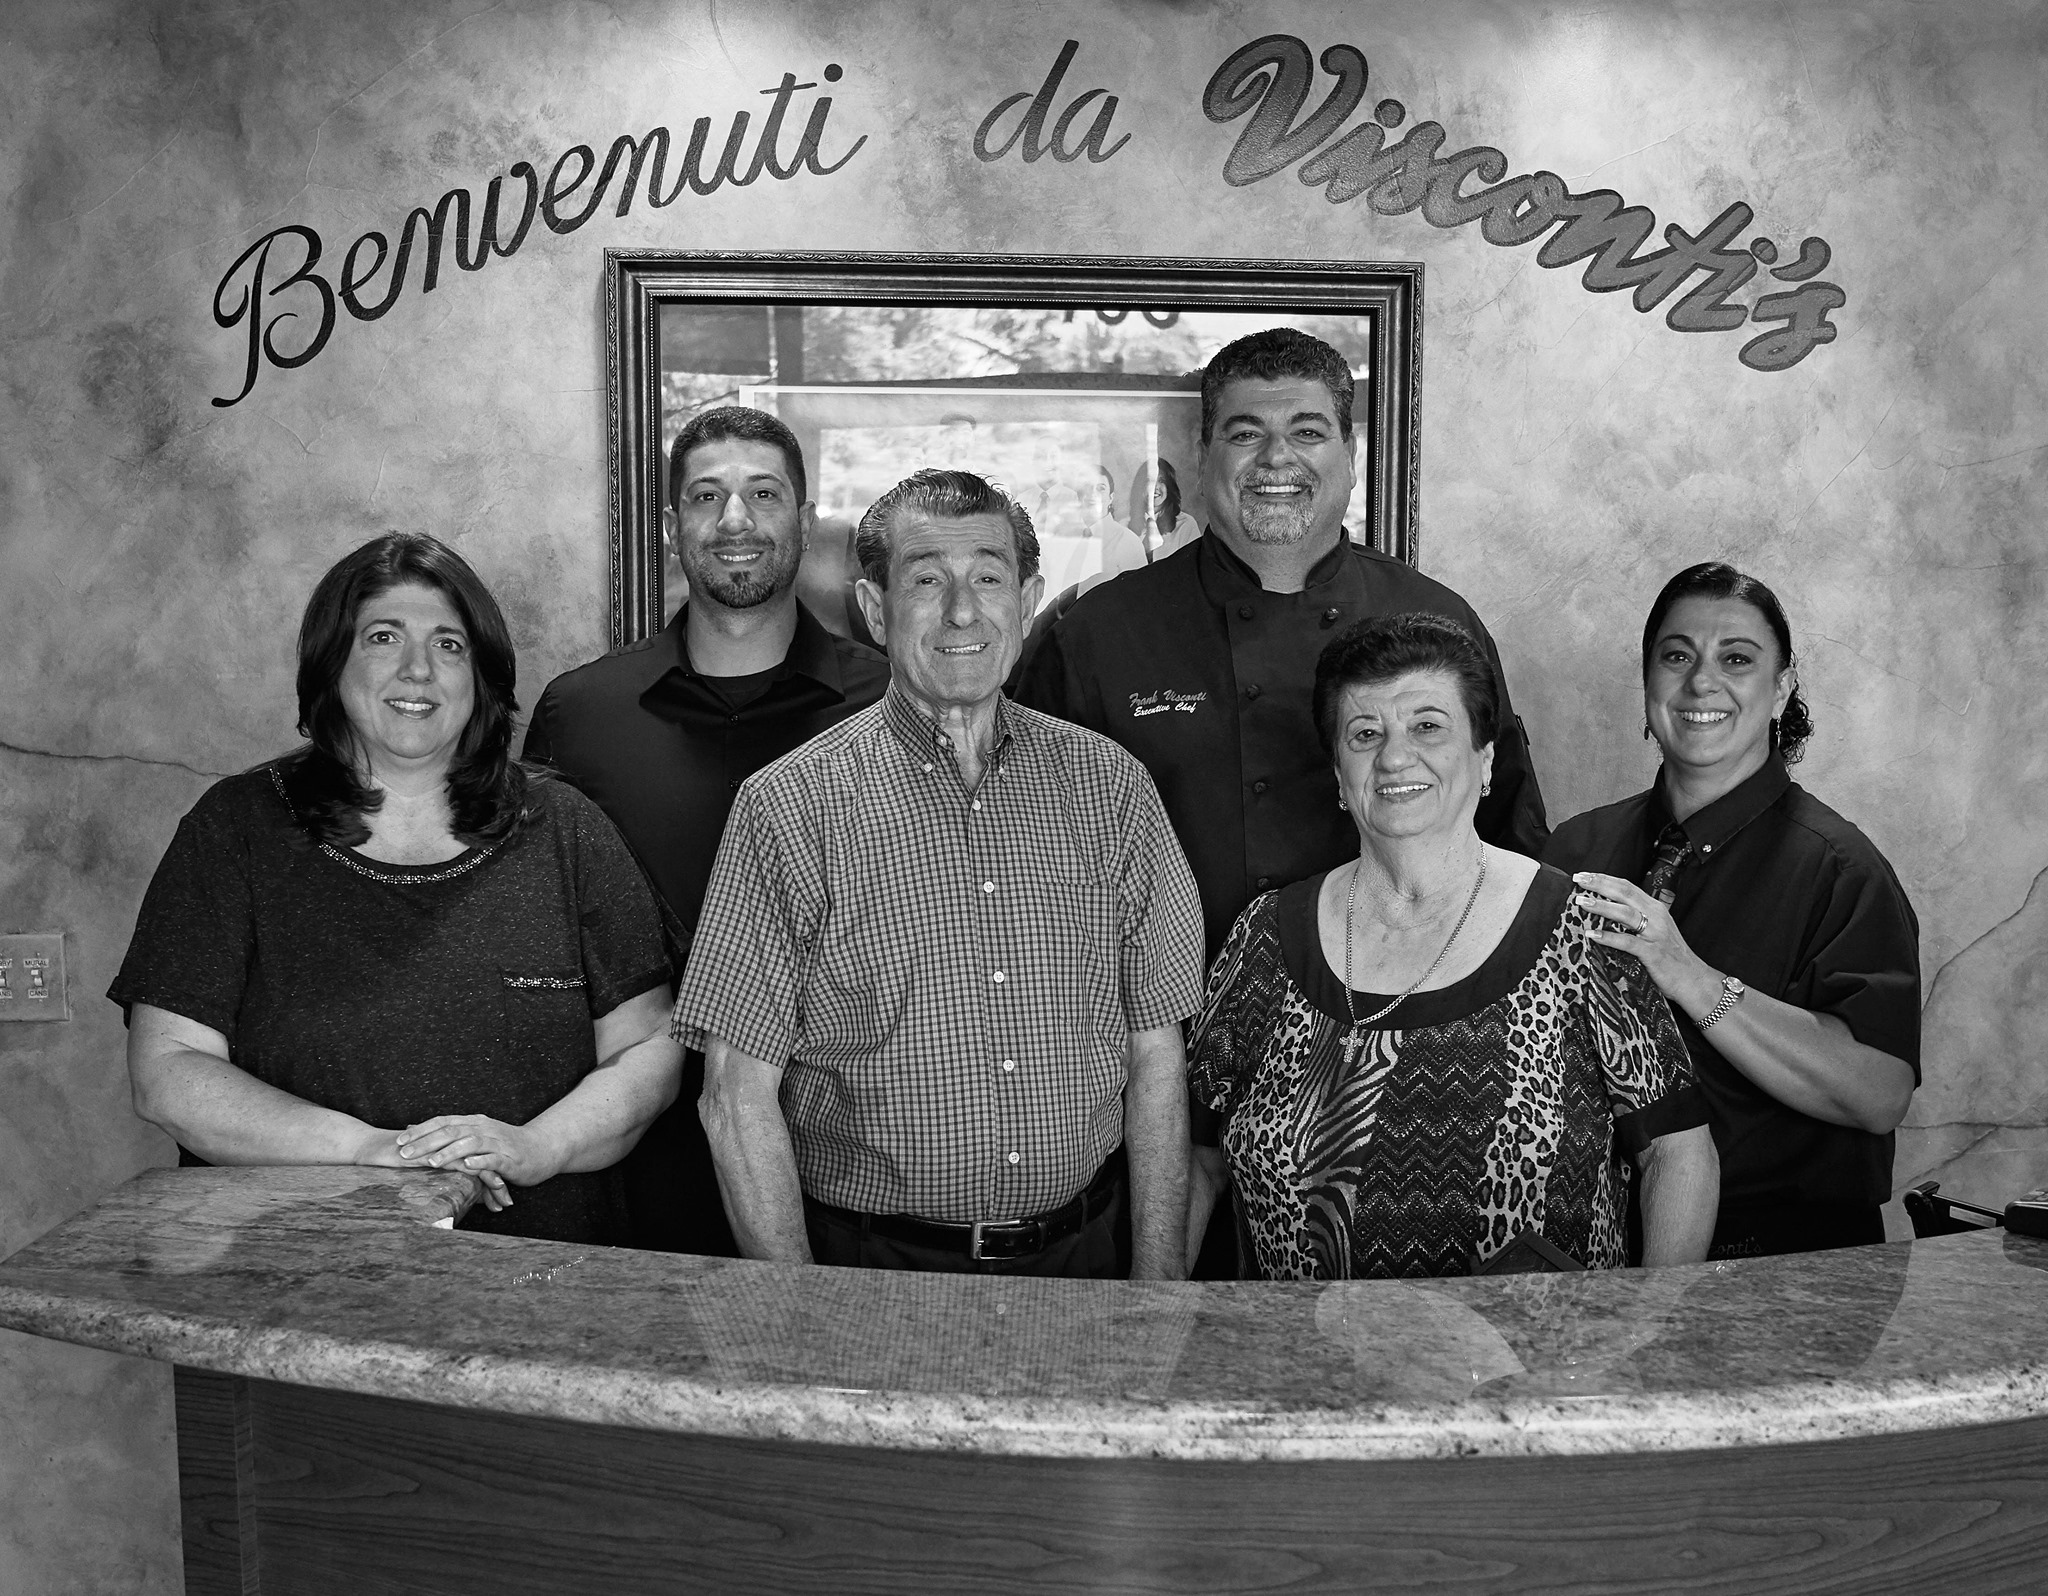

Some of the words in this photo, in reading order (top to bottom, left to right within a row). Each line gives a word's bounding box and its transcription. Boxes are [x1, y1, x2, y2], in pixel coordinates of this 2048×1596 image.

[211, 63, 868, 408] Benvenuti
[972, 39, 1132, 164] da
[1201, 33, 1847, 373] Visconti's
[1128, 689, 1159, 708] Frank
[1163, 689, 1207, 703] Visconti
[1133, 703, 1171, 717] Executive
[1174, 701, 1197, 714] Chef
